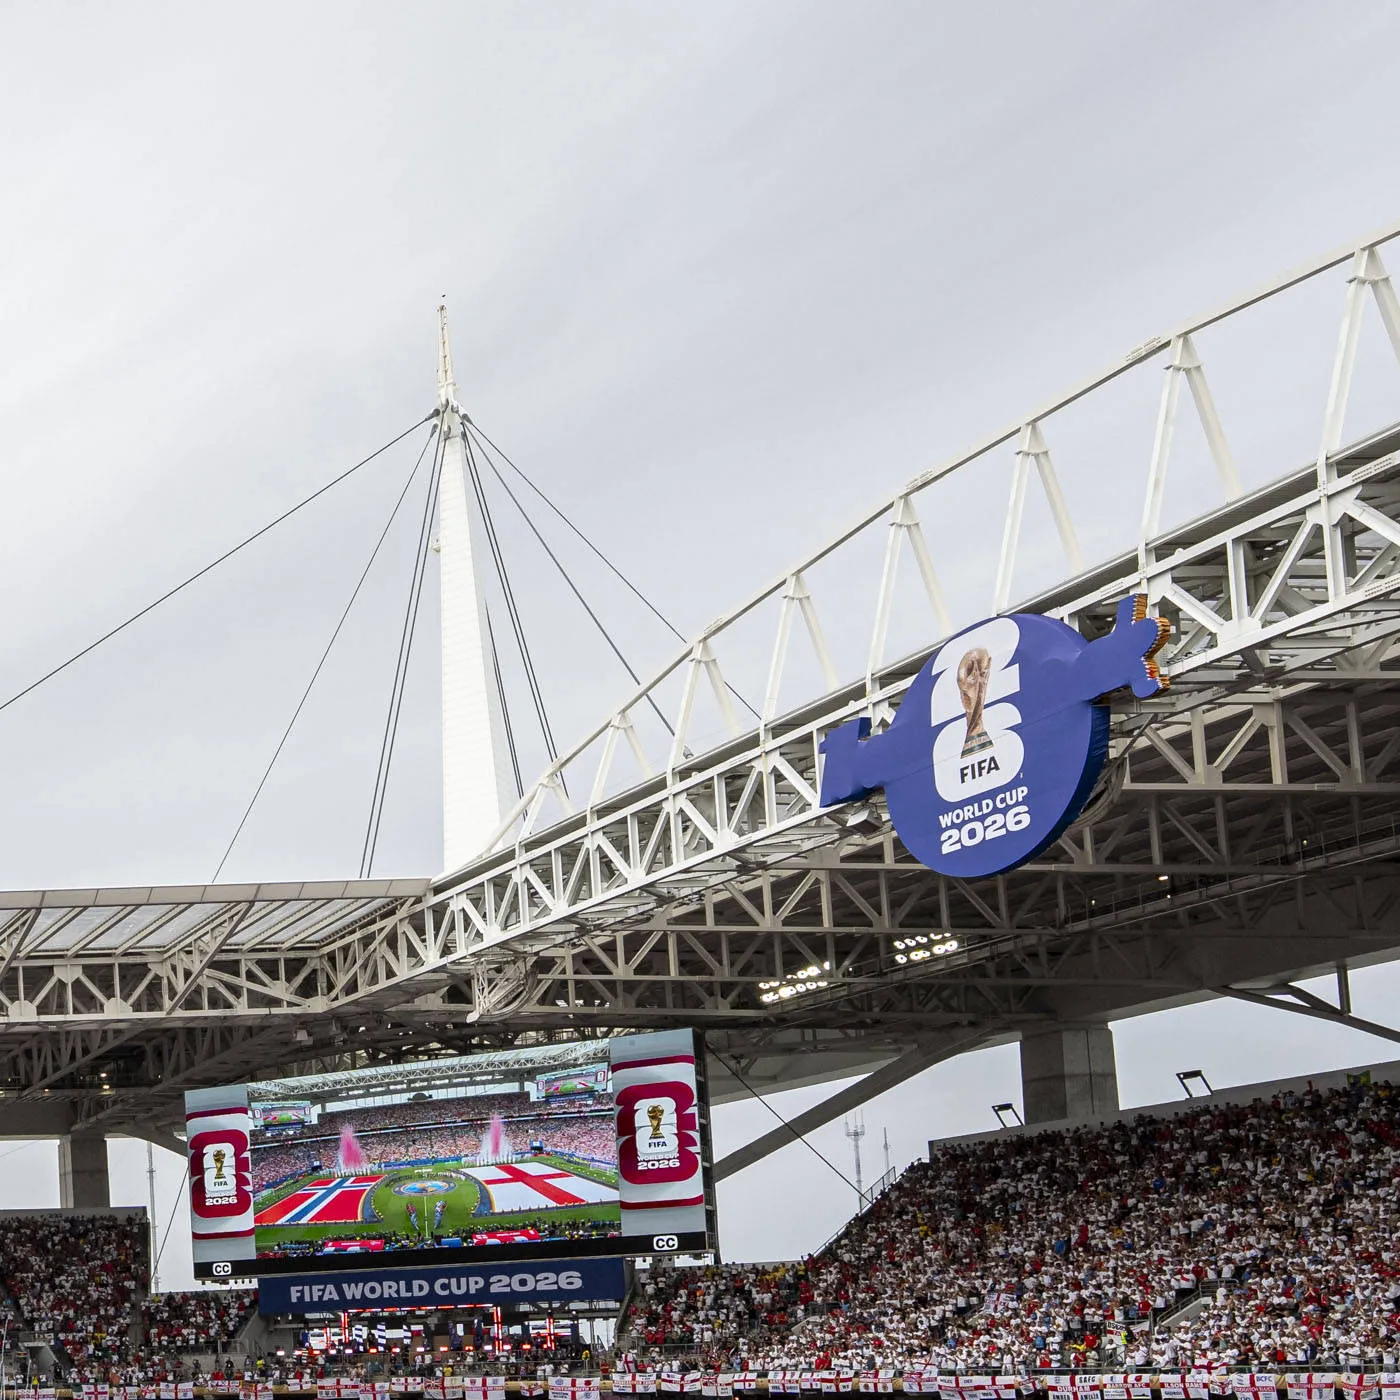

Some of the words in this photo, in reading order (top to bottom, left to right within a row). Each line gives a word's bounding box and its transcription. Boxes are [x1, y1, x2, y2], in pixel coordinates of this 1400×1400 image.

[959, 756, 1000, 784] FIFA
[938, 799, 993, 828] WORLD
[996, 785, 1029, 809] CUP
[940, 806, 1032, 855] 2026
[637, 1159, 680, 1170] 2026
[205, 1196, 238, 1205] 2026
[655, 1238, 676, 1248] CC
[215, 1264, 230, 1274] CC
[290, 1283, 340, 1303] FIFA
[341, 1279, 430, 1301] WORLD
[434, 1275, 485, 1297] CUP
[489, 1271, 583, 1294] 2026
[1057, 1385, 1091, 1393] DURHAM
